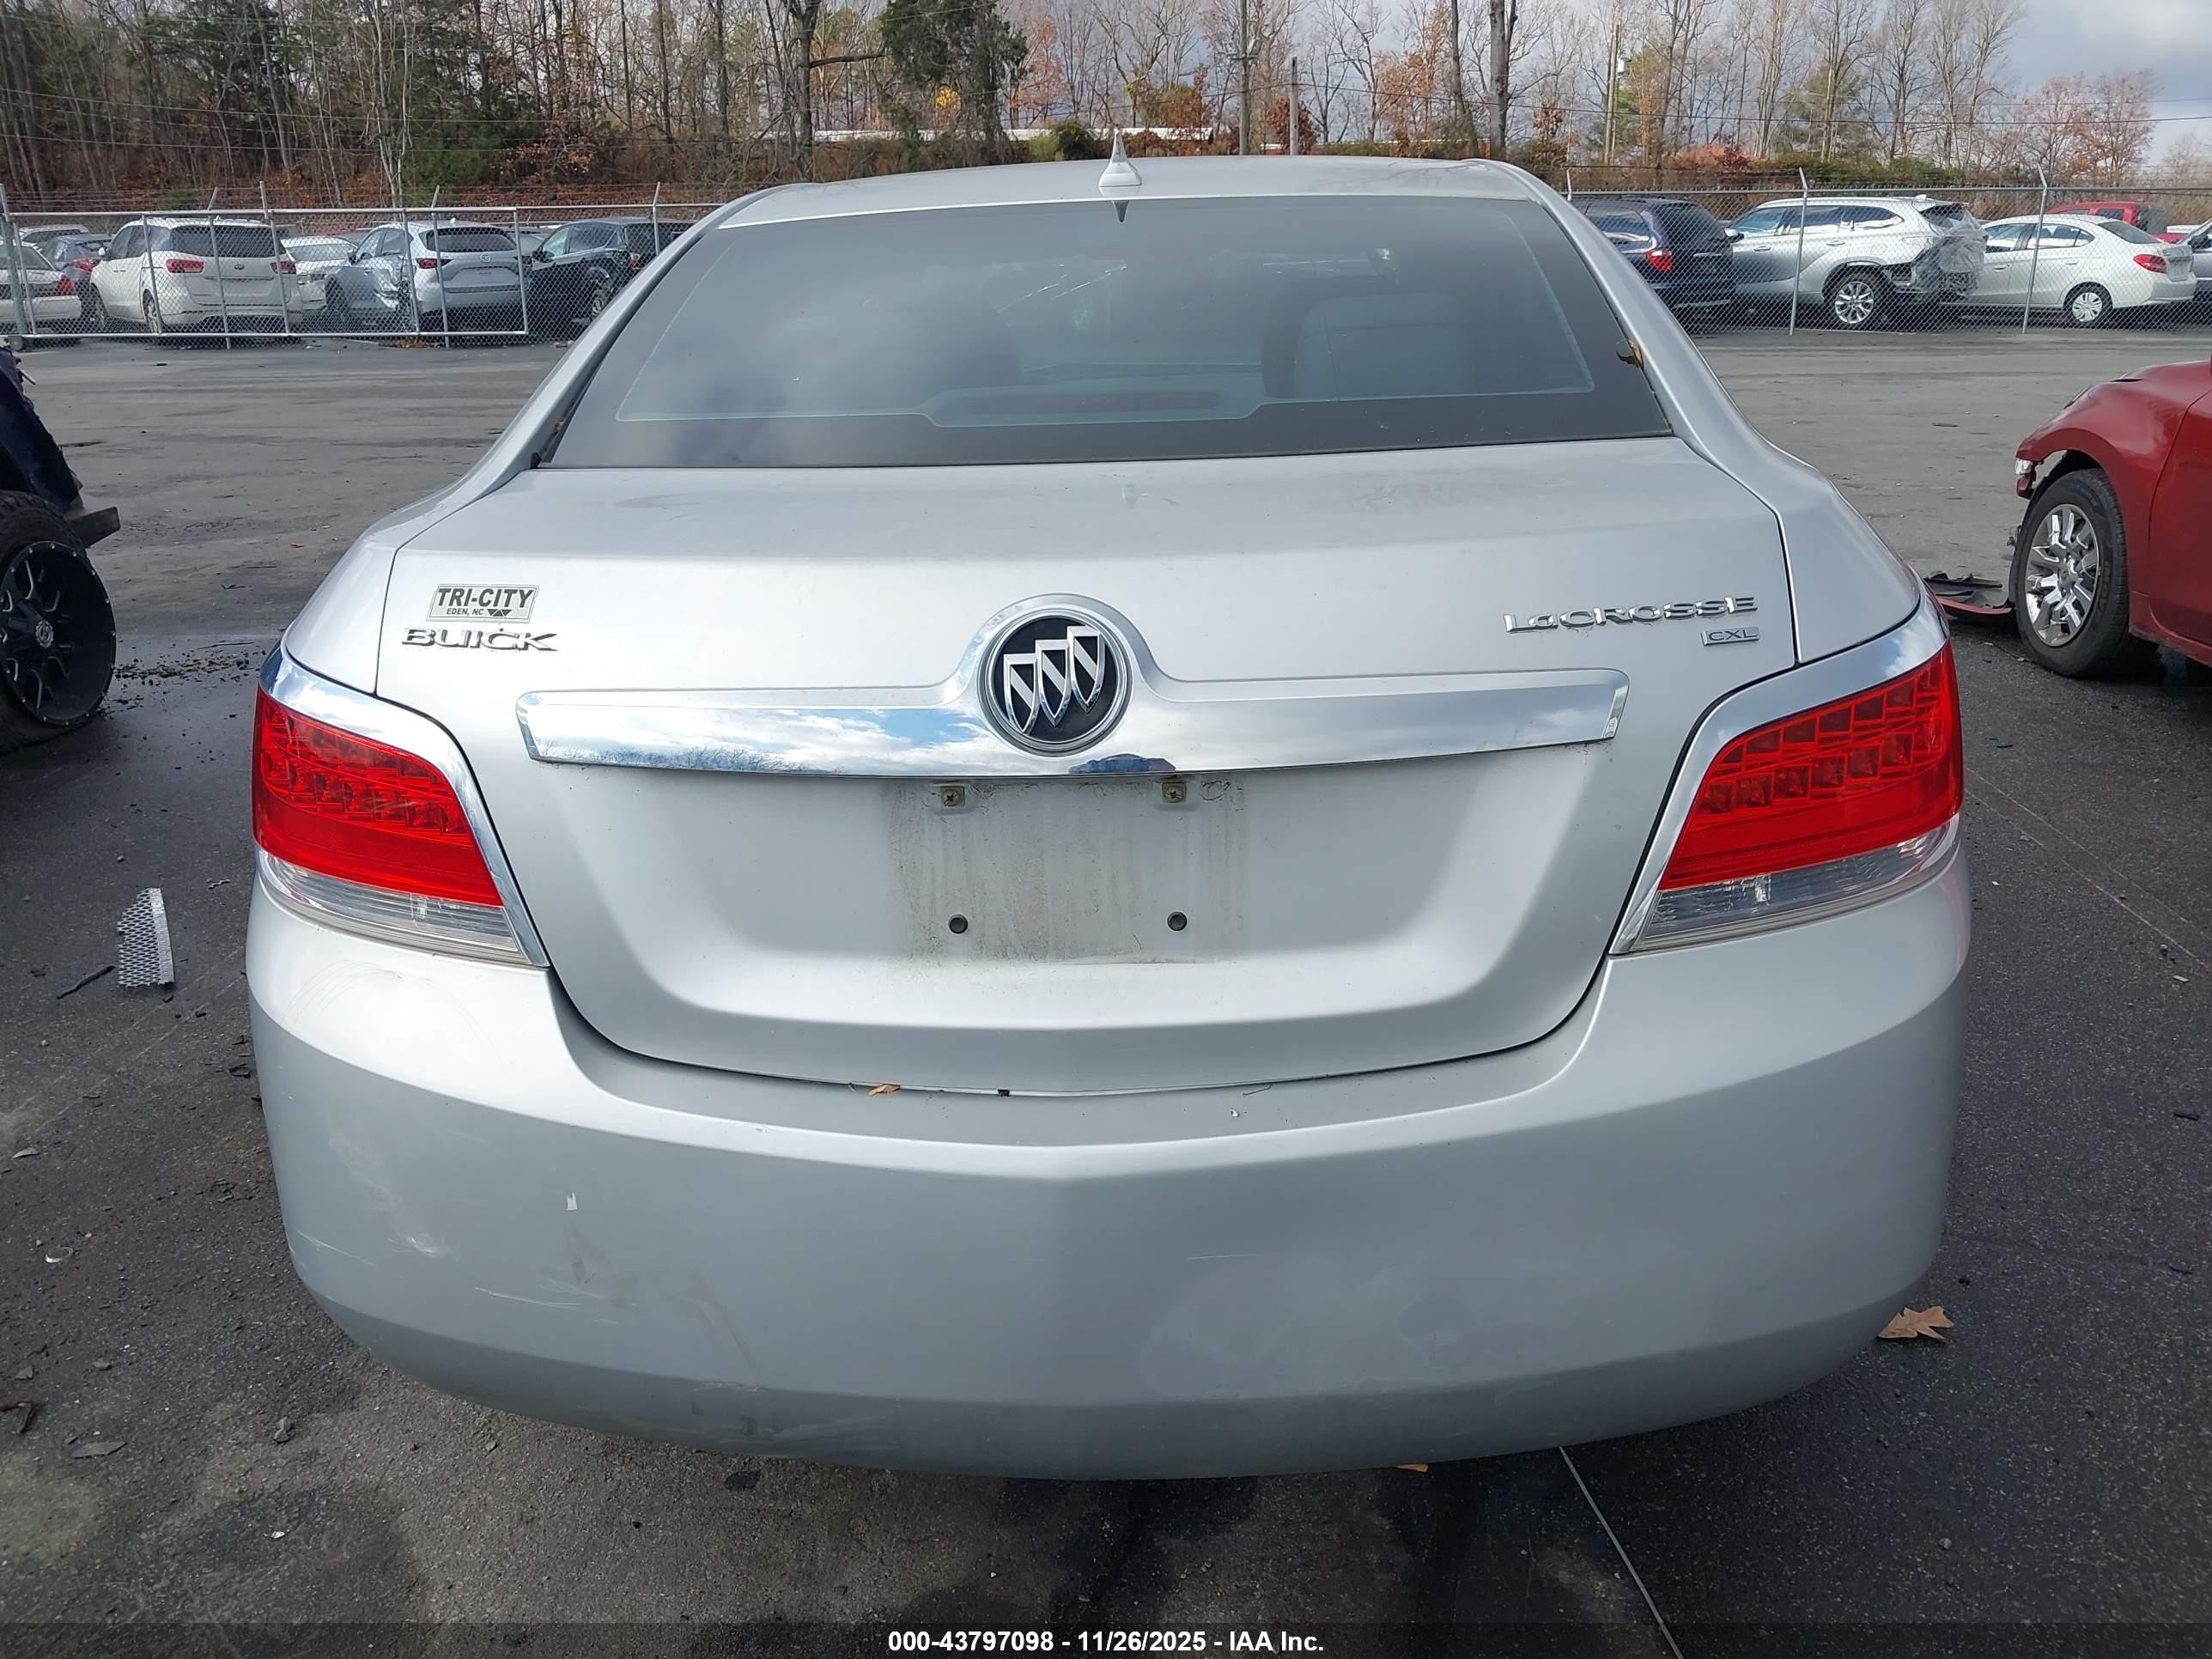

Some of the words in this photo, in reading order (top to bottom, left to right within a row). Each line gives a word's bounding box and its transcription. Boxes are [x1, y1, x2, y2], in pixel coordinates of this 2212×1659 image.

[437, 588, 533, 608] TRI-CITY
[401, 627, 557, 652] BUICK
[1708, 629, 1758, 641] CXL
